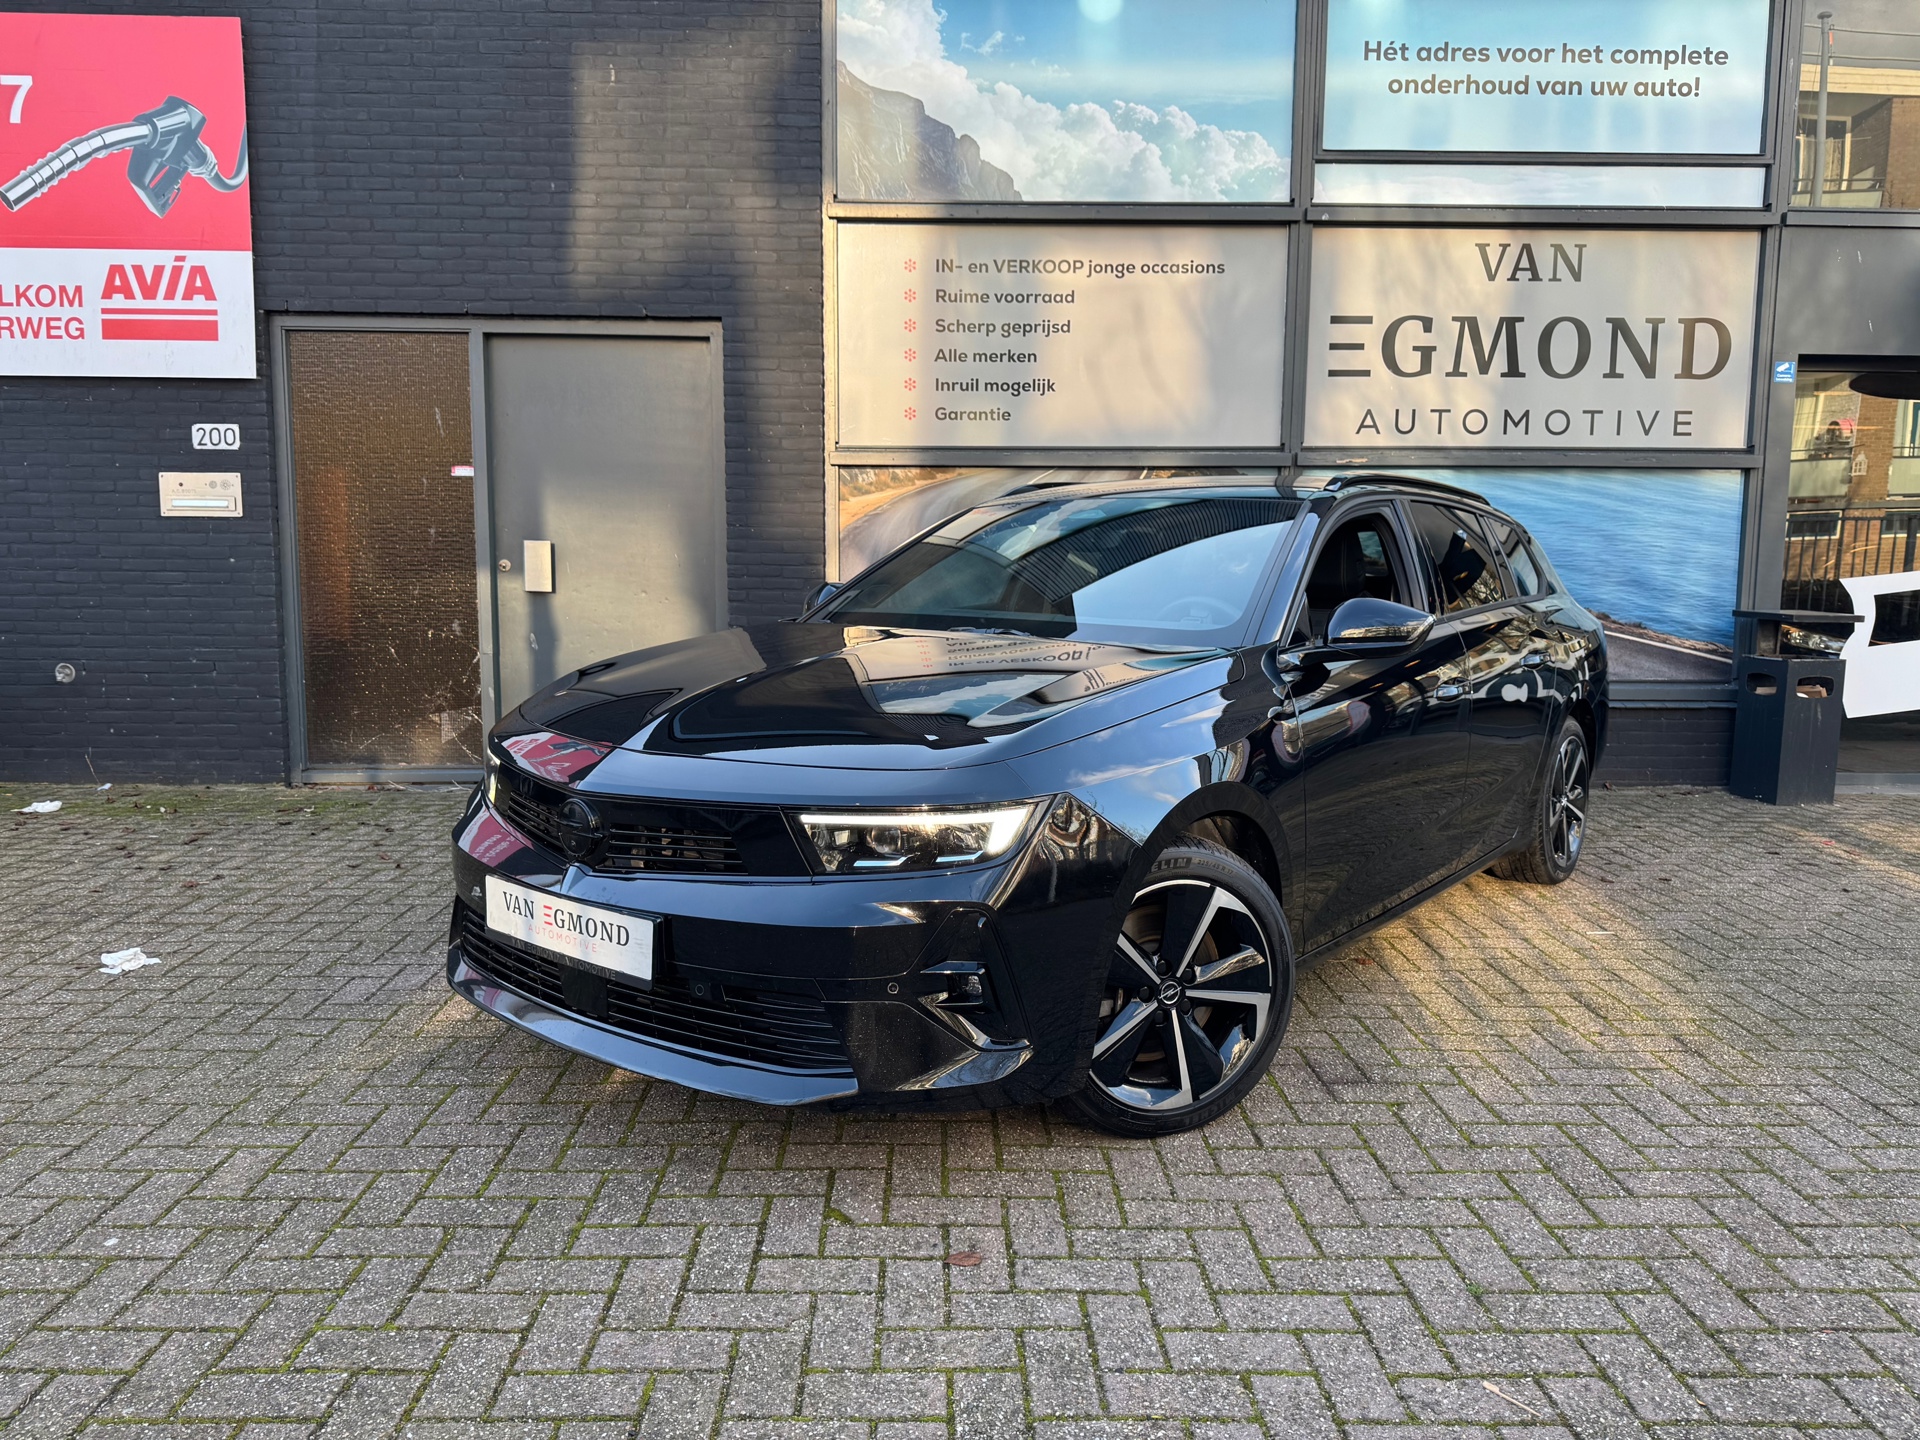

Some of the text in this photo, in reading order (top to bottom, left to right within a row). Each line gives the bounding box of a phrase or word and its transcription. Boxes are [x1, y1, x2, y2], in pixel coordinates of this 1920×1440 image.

[1362, 40, 1729, 71] Hét adres voor het complete
[1387, 74, 1702, 98] onderhoud van uw auto!
[935, 259, 1226, 279] IN- en VERKOOP jonge occasions
[1474, 242, 1588, 284] VAN
[935, 288, 1076, 304] Ruime voorraad
[0, 315, 86, 340] RWEG
[935, 318, 1072, 338] Scherp geprijsd
[934, 348, 1038, 364] Alle merken
[1327, 313, 1733, 381] EGMOND
[935, 377, 1057, 397] Inruil mogelijk
[934, 406, 1012, 422] Garantie
[1355, 408, 1694, 437] AUTOMOTIVE
[195, 427, 236, 447] 200
[502, 890, 631, 948] VAN EGMOND
[527, 923, 599, 954] AUTOMOTIVE
[563, 956, 617, 981] AUTOMOTIVE
